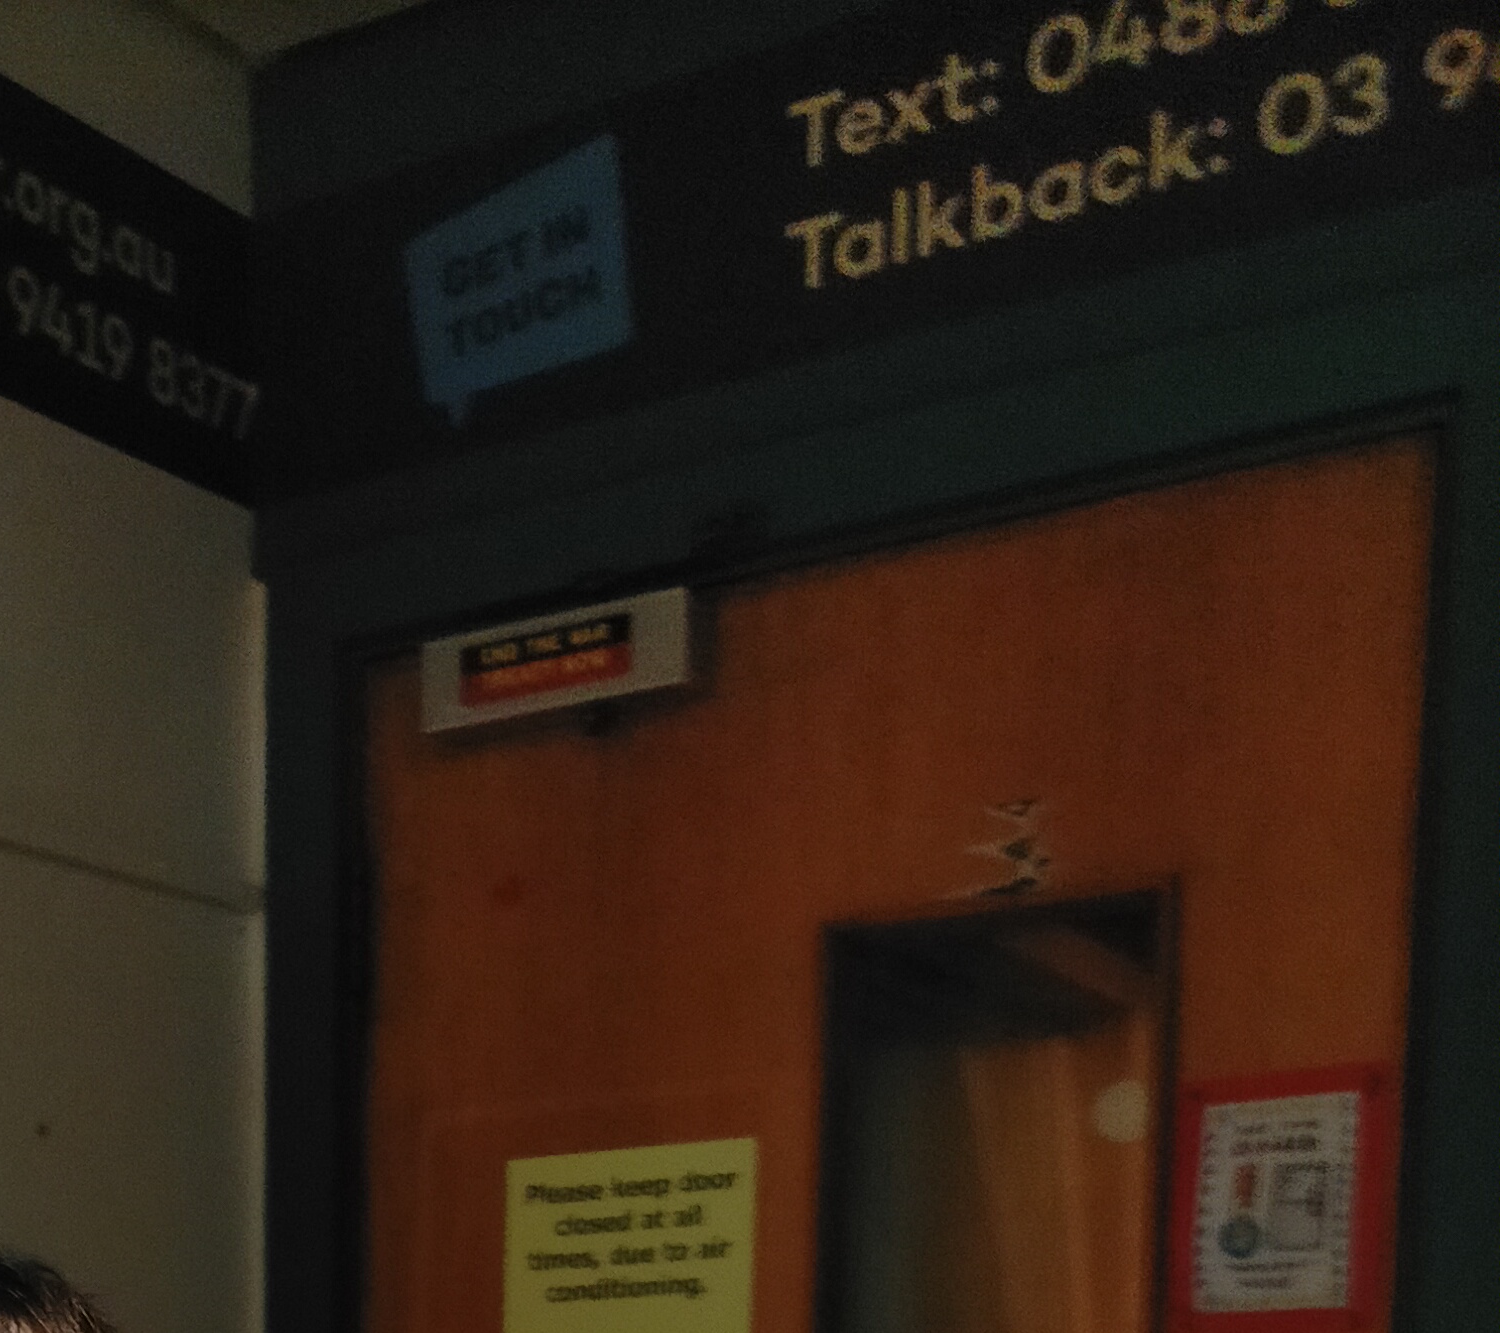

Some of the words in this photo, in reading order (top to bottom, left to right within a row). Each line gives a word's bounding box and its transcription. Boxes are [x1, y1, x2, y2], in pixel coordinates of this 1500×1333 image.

[784, 53, 1000, 168] Text:
[784, 110, 1231, 290] Talkback:
[1257, 52, 1389, 155] 03
[1422, 27, 1500, 112] 9
[442, 229, 530, 298] GET
[6, 265, 135, 383] 9419
[147, 336, 261, 441] 8377
[525, 1183, 604, 1204] Please
[611, 1176, 671, 1198] keep
[679, 1170, 737, 1192] door
[555, 1210, 631, 1236] closed
[640, 1210, 663, 1230] at
[673, 1205, 703, 1228] all
[610, 1245, 655, 1266] due
[662, 1242, 688, 1262] to
